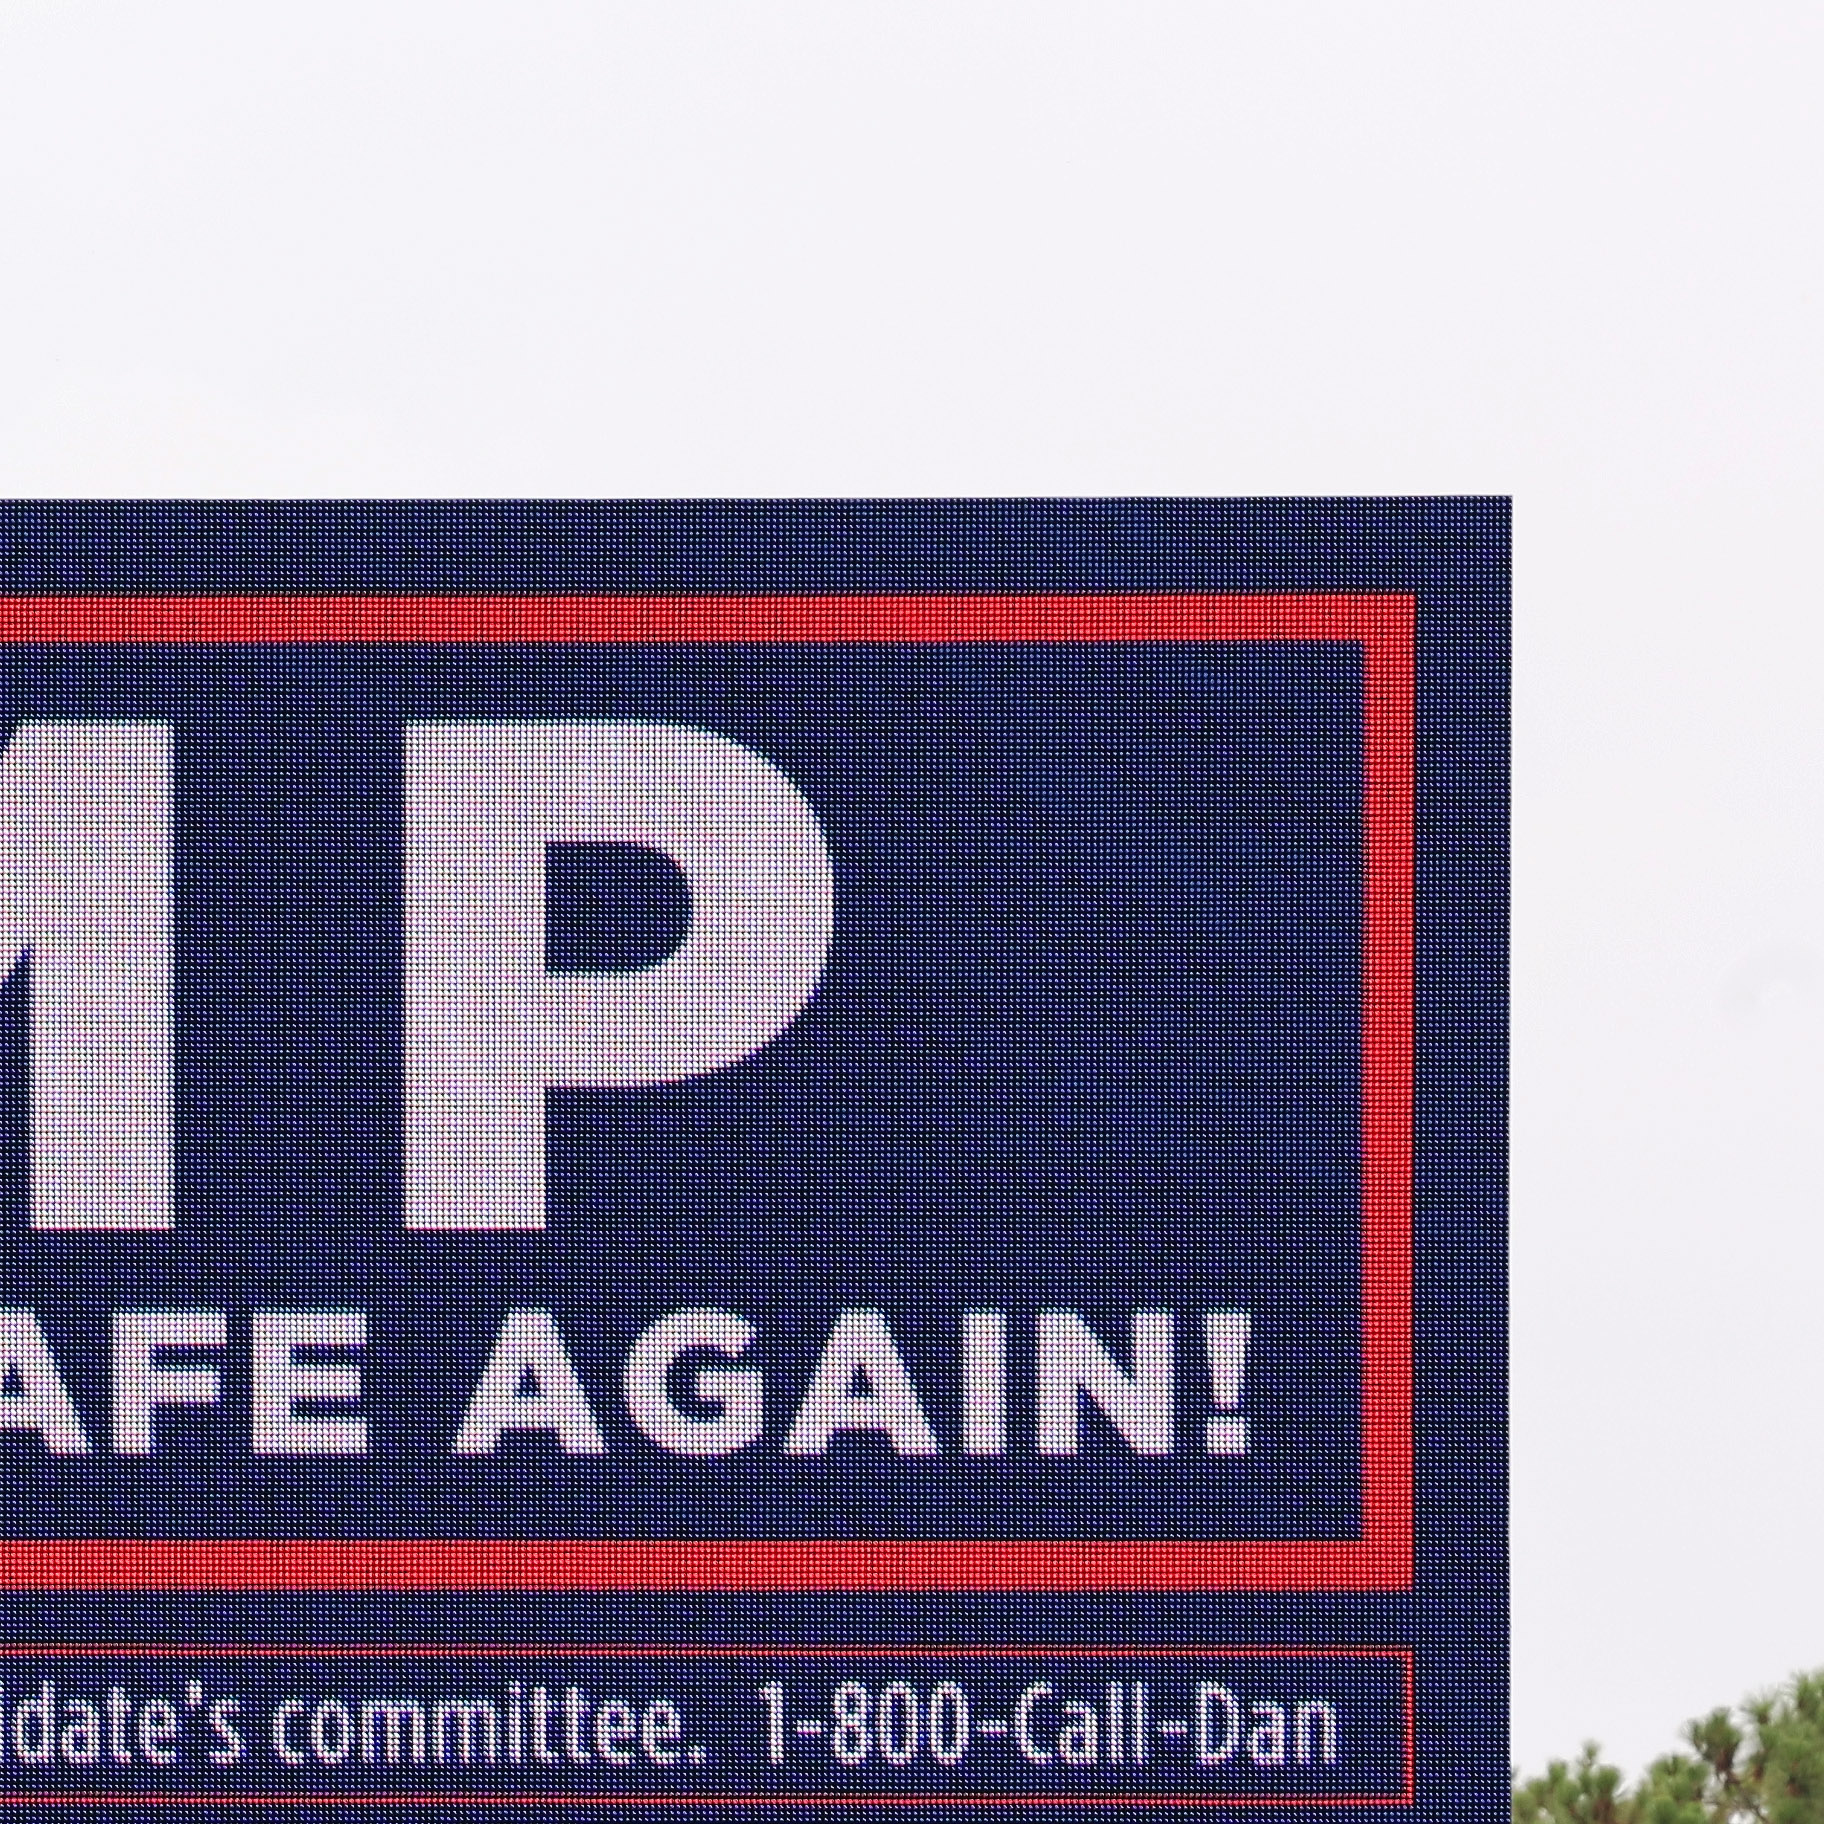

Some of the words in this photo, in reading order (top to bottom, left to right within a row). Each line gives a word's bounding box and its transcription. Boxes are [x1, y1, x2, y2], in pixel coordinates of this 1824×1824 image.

[454, 1308, 1249, 1456] AGAIN!
[273, 1684, 705, 1764] committee.
[760, 1682, 1338, 1764] 1-800-Call-Dan
